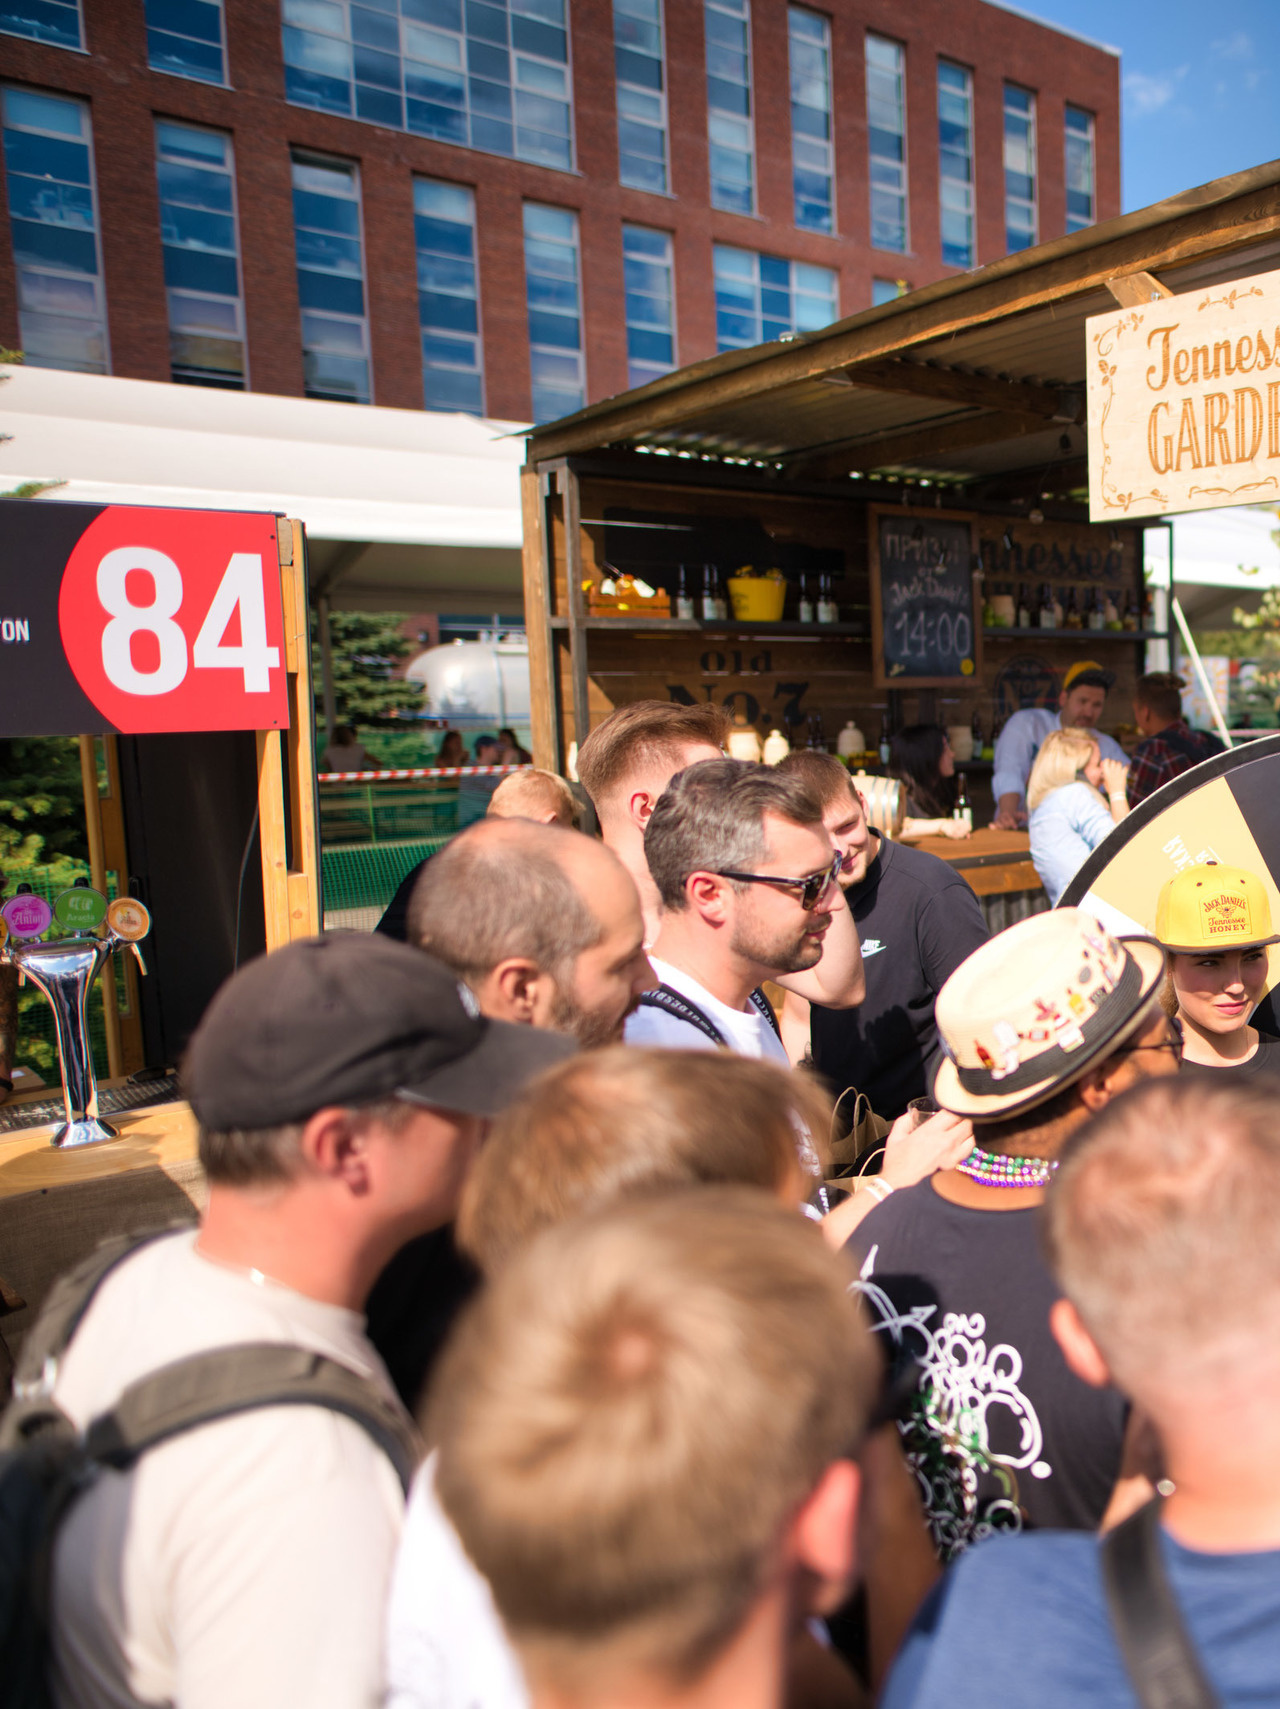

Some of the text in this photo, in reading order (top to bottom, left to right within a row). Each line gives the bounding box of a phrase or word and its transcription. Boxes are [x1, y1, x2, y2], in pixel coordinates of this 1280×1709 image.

[0, 617, 31, 643] ON
[96, 546, 281, 696] 84
[895, 611, 972, 657] 14:00
[1203, 898, 1221, 913] JACK
[1208, 917, 1246, 926] Tennessee
[1209, 924, 1246, 933] HONEY
